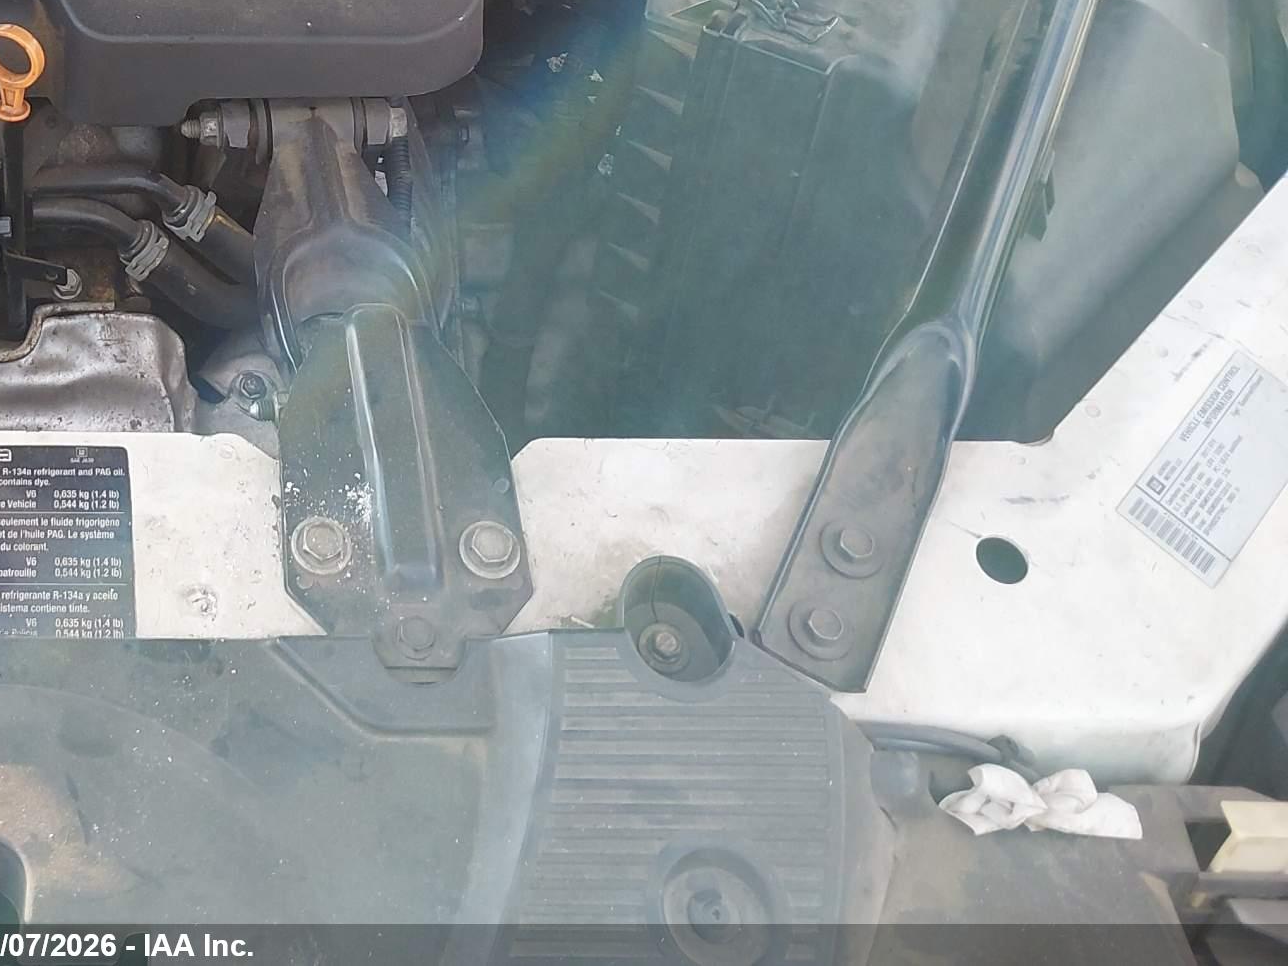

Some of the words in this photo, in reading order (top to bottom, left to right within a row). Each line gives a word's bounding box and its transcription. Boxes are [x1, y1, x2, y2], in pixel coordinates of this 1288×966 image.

[2, 468, 31, 476] R-134a
[33, 468, 75, 477] refrigerant
[78, 468, 93, 476] and
[34, 478, 50, 487] dye.
[26, 490, 37, 498] V6
[78, 490, 89, 500] kg
[91, 490, 107, 499] (1.4
[109, 490, 120, 499] lb)
[7, 500, 37, 508] Vehicle
[78, 500, 89, 510] kg
[91, 500, 107, 509] (1.2
[109, 500, 120, 509] lb)
[40, 517, 49, 526] le
[50, 517, 73, 526] fluide
[7, 530, 18, 539] de
[20, 530, 45, 539] l'huile
[67, 530, 77, 539] Le
[79, 530, 114, 540] système
[0, 542, 11, 551] du
[13, 542, 49, 551] colorant.
[26, 558, 37, 566] V6
[80, 558, 90, 568] kg
[93, 558, 109, 567] (1.4
[111, 558, 122, 567] lb)
[80, 568, 91, 578] kg
[93, 568, 109, 578] (1.2
[111, 568, 122, 578] lb)
[1, 590, 51, 602] refrigerante
[53, 591, 84, 600] R-134a
[30, 604, 67, 613] contiene
[26, 618, 37, 627] V6
[81, 618, 92, 629] kg
[94, 618, 110, 628] (1.4
[112, 618, 123, 628] lb)
